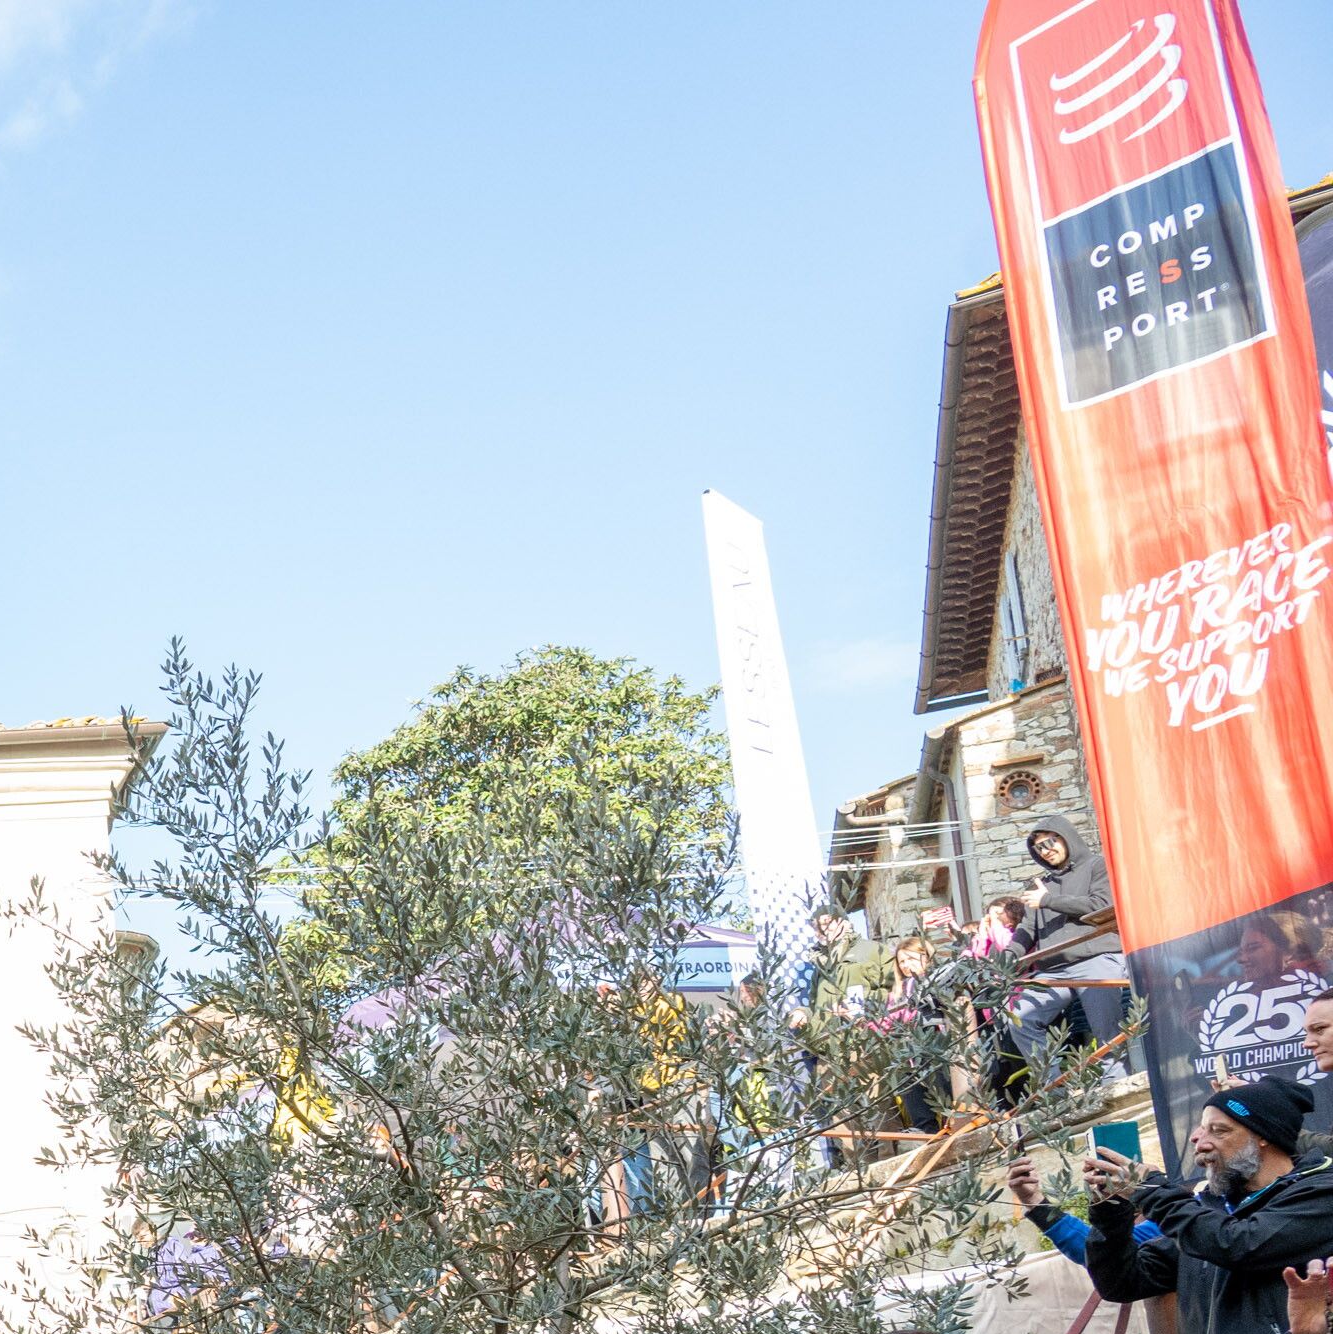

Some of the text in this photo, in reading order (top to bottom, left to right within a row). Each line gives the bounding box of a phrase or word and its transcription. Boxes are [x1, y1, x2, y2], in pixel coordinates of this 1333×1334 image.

[1089, 202, 1206, 269] COMP
[1096, 245, 1213, 311] RESS
[1103, 286, 1217, 352] PORT
[1085, 535, 1333, 673] YOU RACE
[1100, 522, 1292, 622] WHEREVER
[1103, 590, 1321, 698] WE SUPPORT
[1166, 647, 1270, 728] YOU
[1195, 1052, 1242, 1074] WOLD
